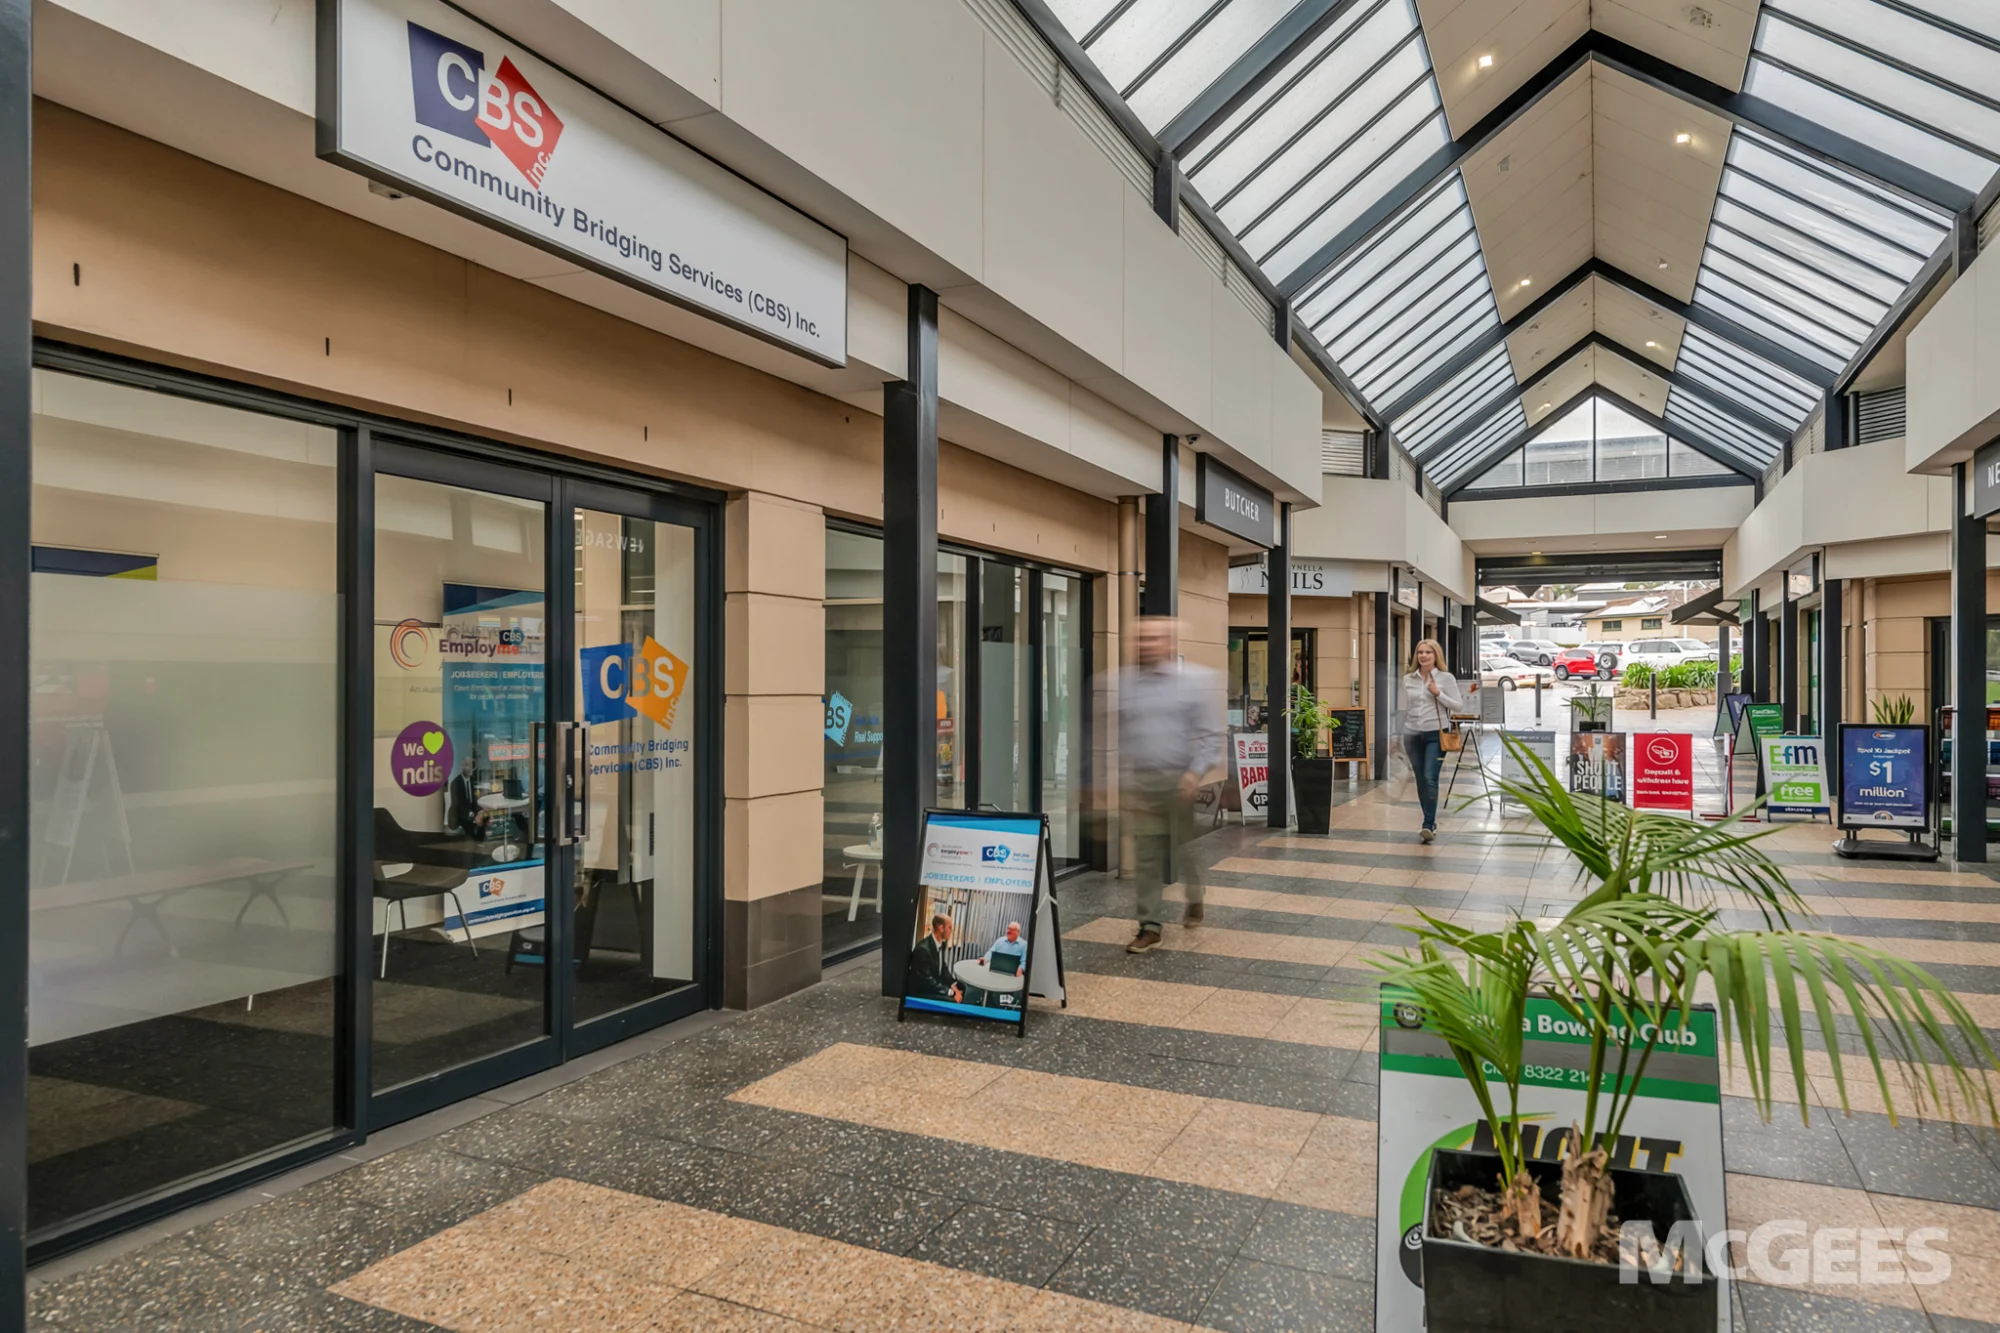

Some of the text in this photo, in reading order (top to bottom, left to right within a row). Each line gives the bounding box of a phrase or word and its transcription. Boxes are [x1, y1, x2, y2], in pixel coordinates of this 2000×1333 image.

[437, 52, 544, 148] CBS
[412, 134, 820, 338] Community Bridging Services (CBS) Inc.
[1225, 488, 1260, 522] BUTCHER
[1260, 570, 1324, 590] NILS
[502, 631, 522, 642] CBS
[600, 654, 675, 699] CBS
[824, 706, 845, 729] BS
[648, 738, 689, 753] Bridging
[854, 730, 883, 744] Real Suppo
[403, 743, 425, 757] We
[1769, 745, 1818, 765] Efm
[402, 760, 444, 785] ndis
[634, 757, 663, 773] (CBS)
[665, 757, 682, 768] Inc.
[1644, 768, 1674, 776] Deposit
[1869, 761, 1893, 784] $1
[1781, 784, 1814, 796] free
[482, 880, 502, 893] CBS
[923, 872, 1033, 888] JOBSEEKERS EMPLOYERS
[1537, 1014, 1635, 1046] Bowlng
[1524, 1064, 1564, 1081] 8322
[1569, 1068, 1606, 1085] 212
